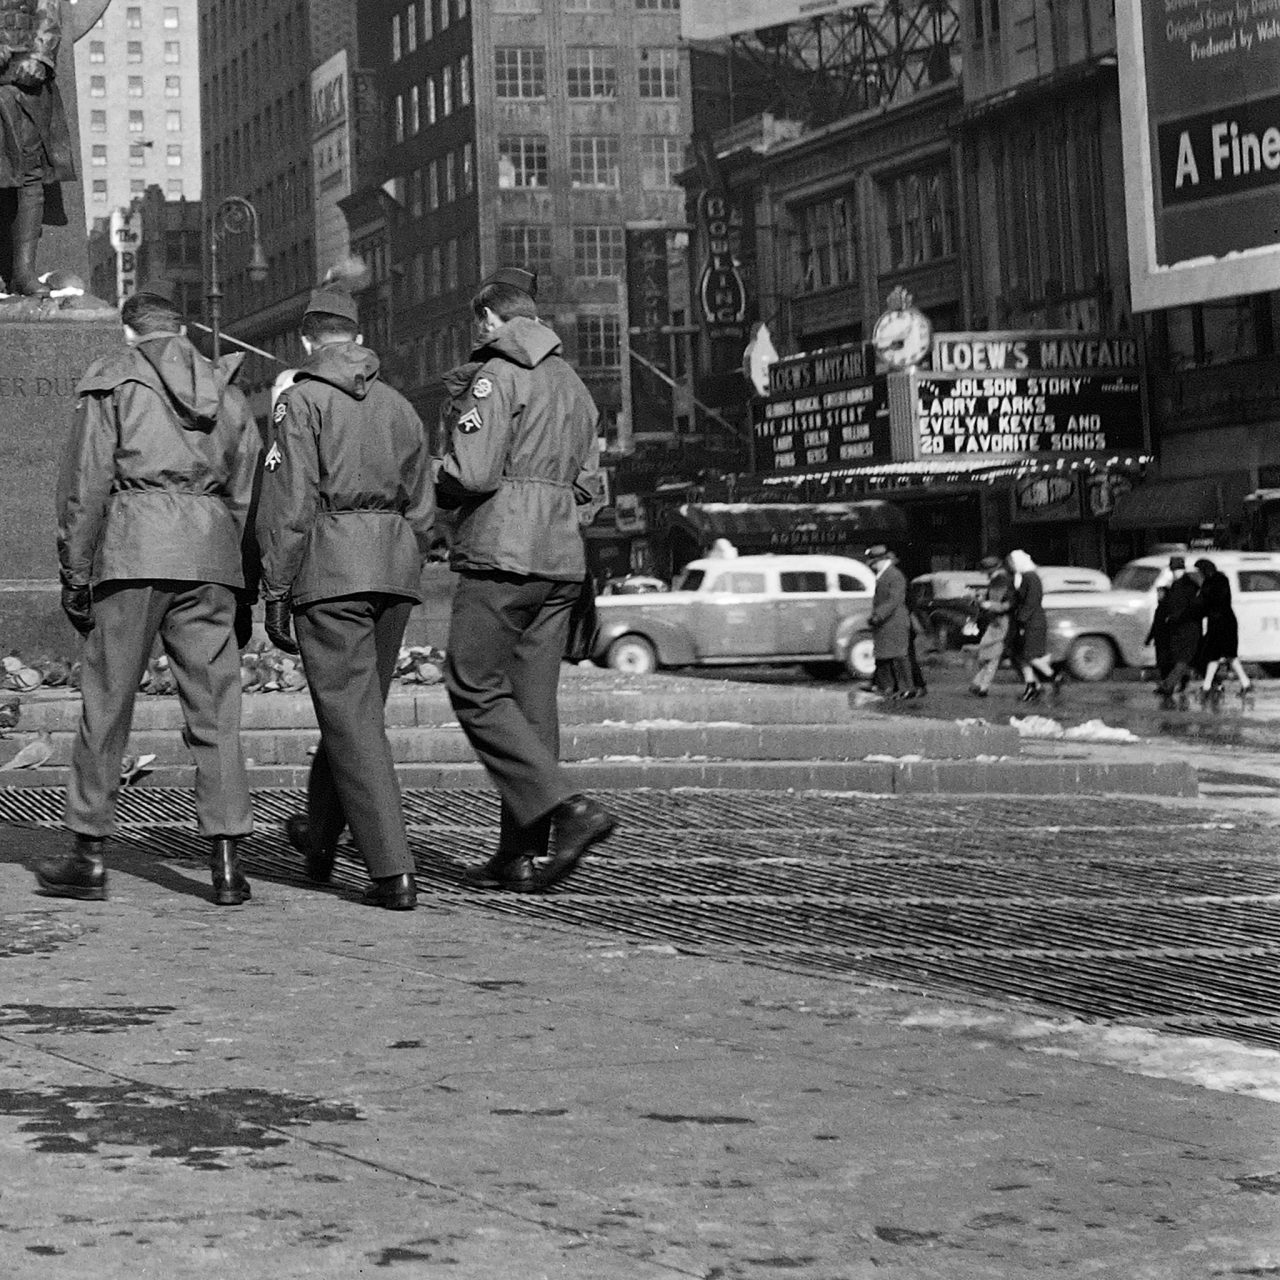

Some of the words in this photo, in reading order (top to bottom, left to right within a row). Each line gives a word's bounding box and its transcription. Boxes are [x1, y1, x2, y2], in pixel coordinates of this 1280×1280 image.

[1191, 29, 1237, 61] Produced
[1240, 26, 1253, 50] by
[1175, 130, 1200, 189] A
[941, 342, 1029, 369] LOEW'S
[1040, 340, 1138, 369] MAYFAIR
[950, 378, 1017, 397] JOLSON
[919, 396, 977, 416] LARRY
[987, 396, 1046, 415] PARKS
[921, 415, 988, 435] EVELYN
[999, 415, 1055, 433] KEYES
[1067, 414, 1101, 432] AND
[921, 435, 944, 454] 20
[954, 433, 1040, 453] FAVORITE
[1051, 433, 1106, 451] SONGS
